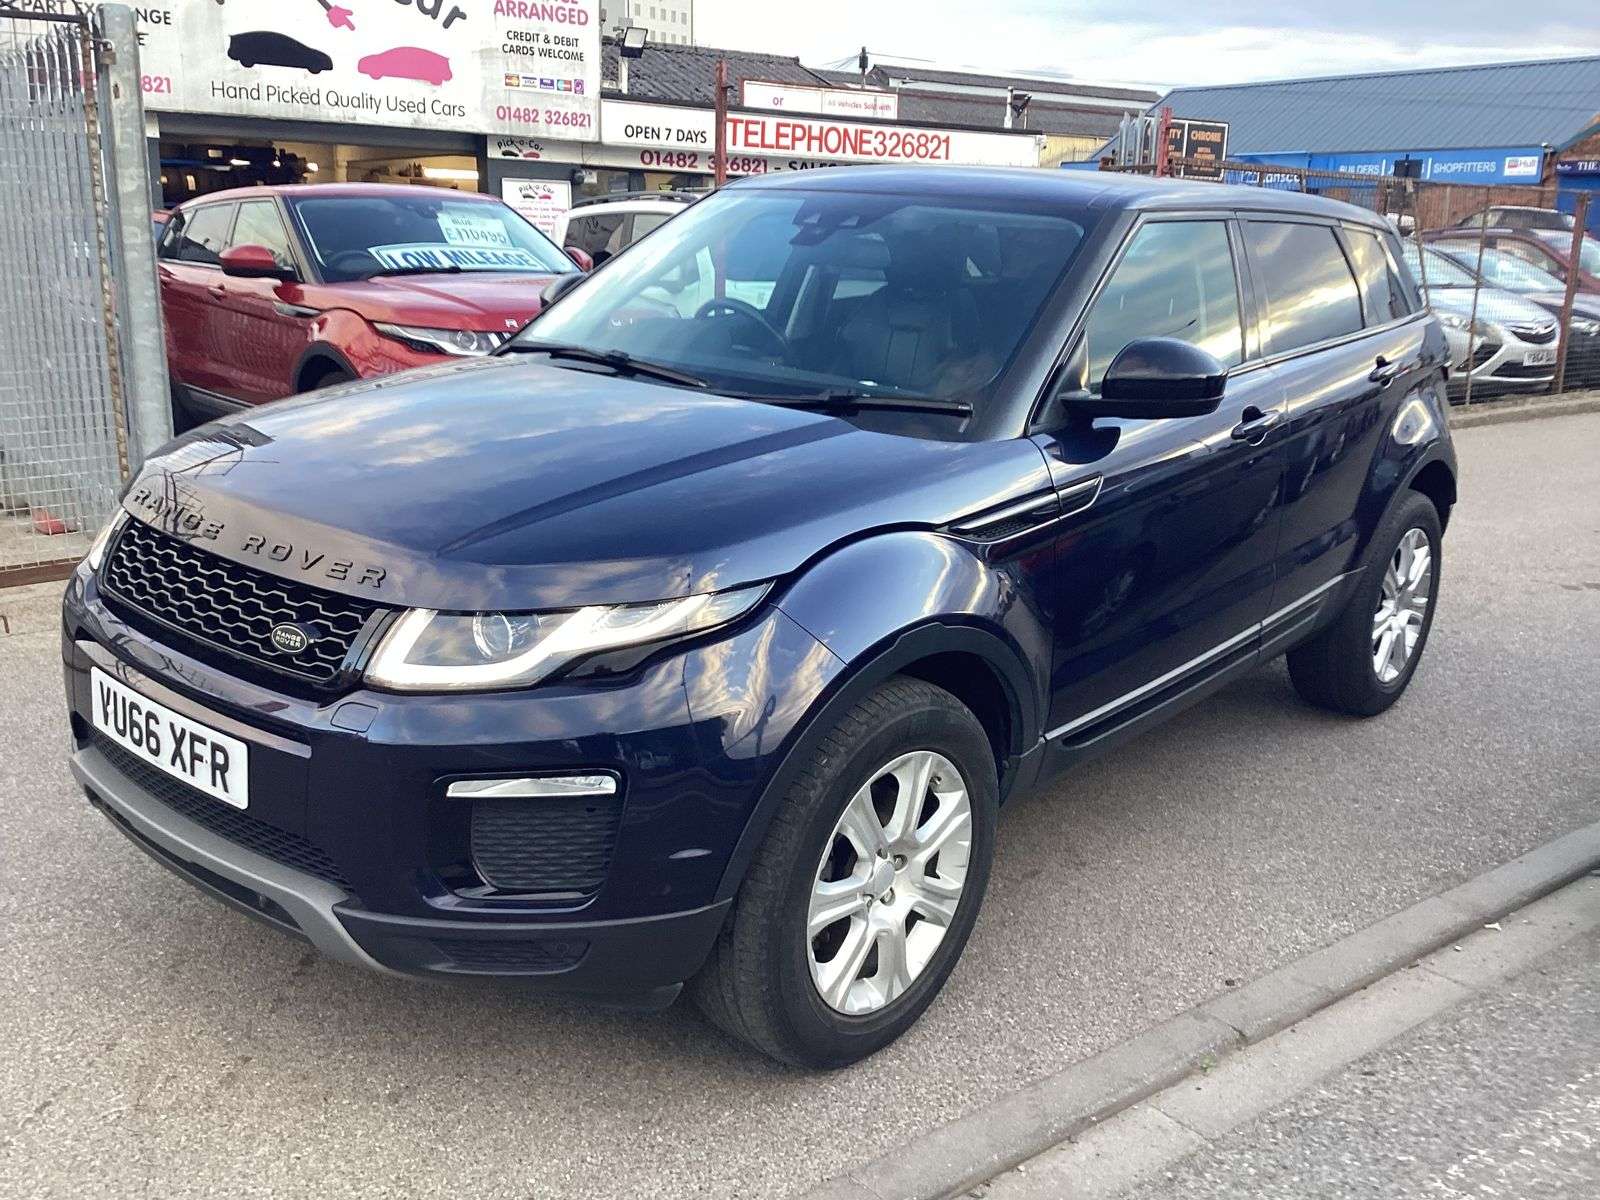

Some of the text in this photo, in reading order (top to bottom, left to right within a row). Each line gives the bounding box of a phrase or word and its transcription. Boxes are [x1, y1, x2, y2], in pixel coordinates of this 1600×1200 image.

[77, 2, 172, 26] EXNGE
[493, 0, 589, 26] ARRANGED
[506, 30, 579, 48] CREDIT & DEBIT
[502, 43, 584, 61] CARDS WELCOME
[211, 80, 466, 117] Hand Picked Quality Used Cars
[496, 105, 591, 128] 01482 326821
[624, 125, 707, 144] OPEN 7 DAYS
[640, 150, 698, 168] 01482
[707, 154, 768, 173] 36821
[1433, 161, 1497, 174] SHOPFITTERS
[385, 250, 538, 269] LOW MILEAGE
[133, 487, 388, 589] RANGE ROVER
[275, 635, 301, 648] ROVER
[276, 630, 302, 642] RANGE
[99, 680, 230, 794] YU66 XFR
